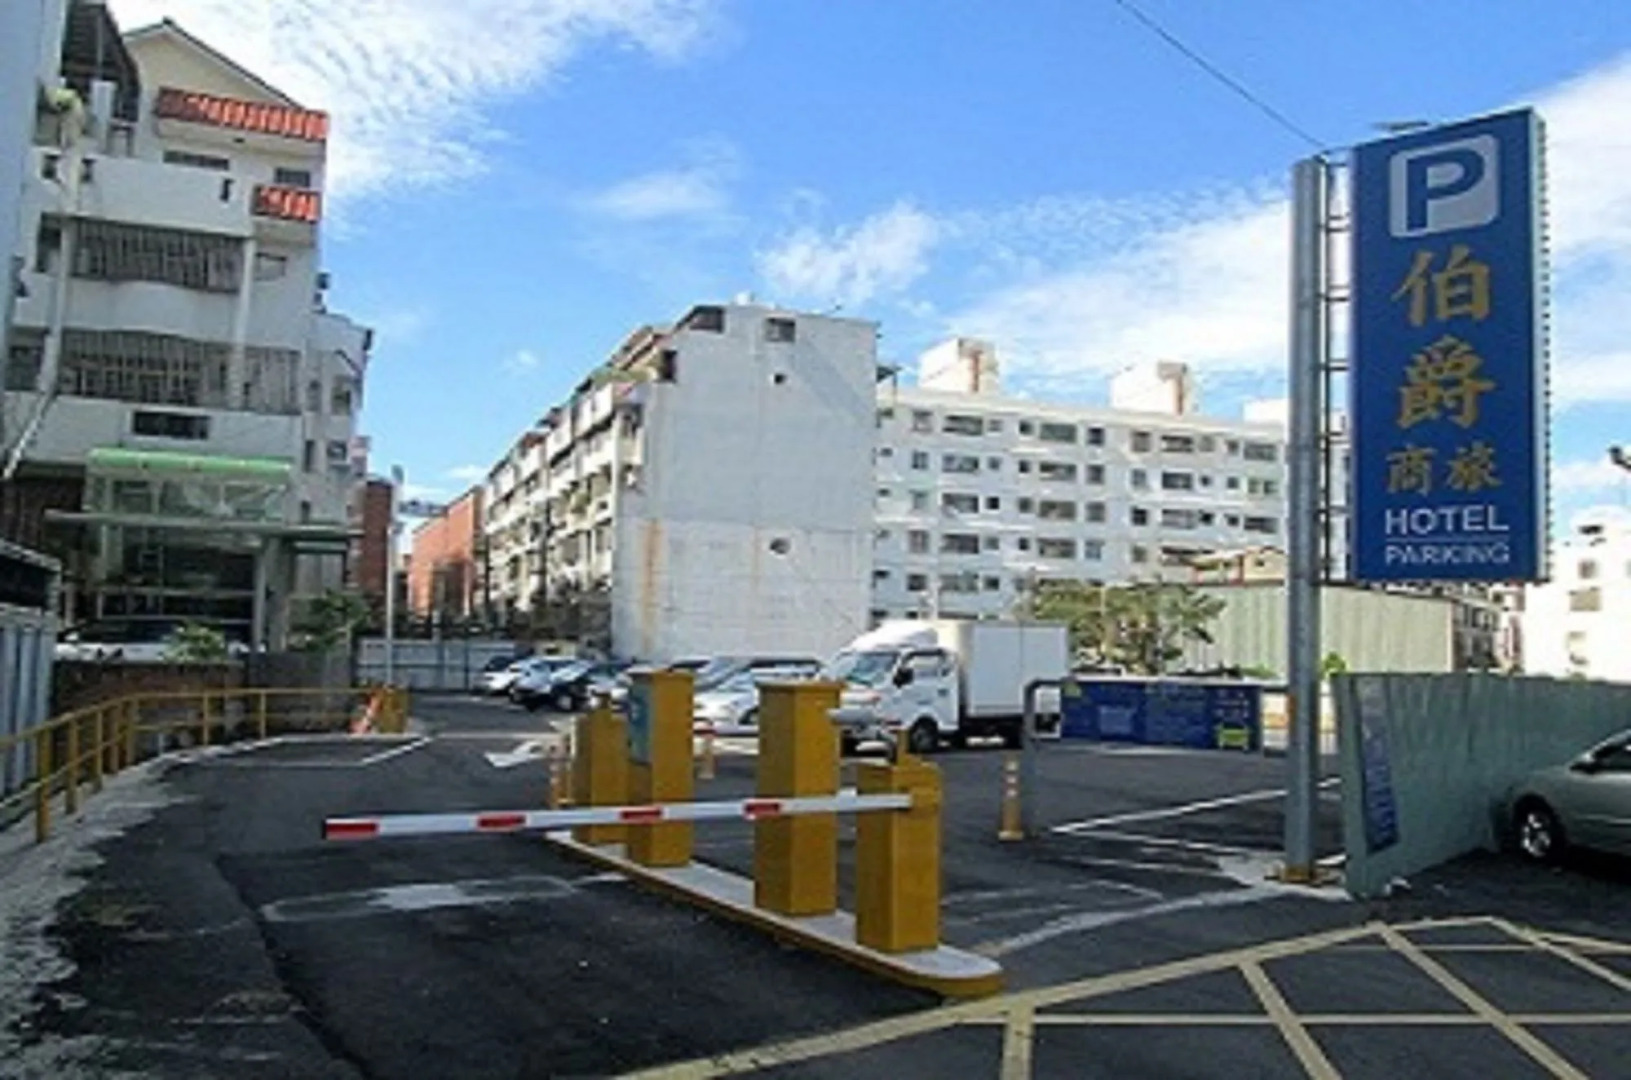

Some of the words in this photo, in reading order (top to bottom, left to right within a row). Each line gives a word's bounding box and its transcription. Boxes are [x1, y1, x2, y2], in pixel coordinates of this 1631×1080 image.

[1407, 149, 1484, 229] P
[1392, 245, 1496, 427] 伯爵
[1385, 505, 1510, 535] HOTEL
[1385, 543, 1510, 565] PARKING
